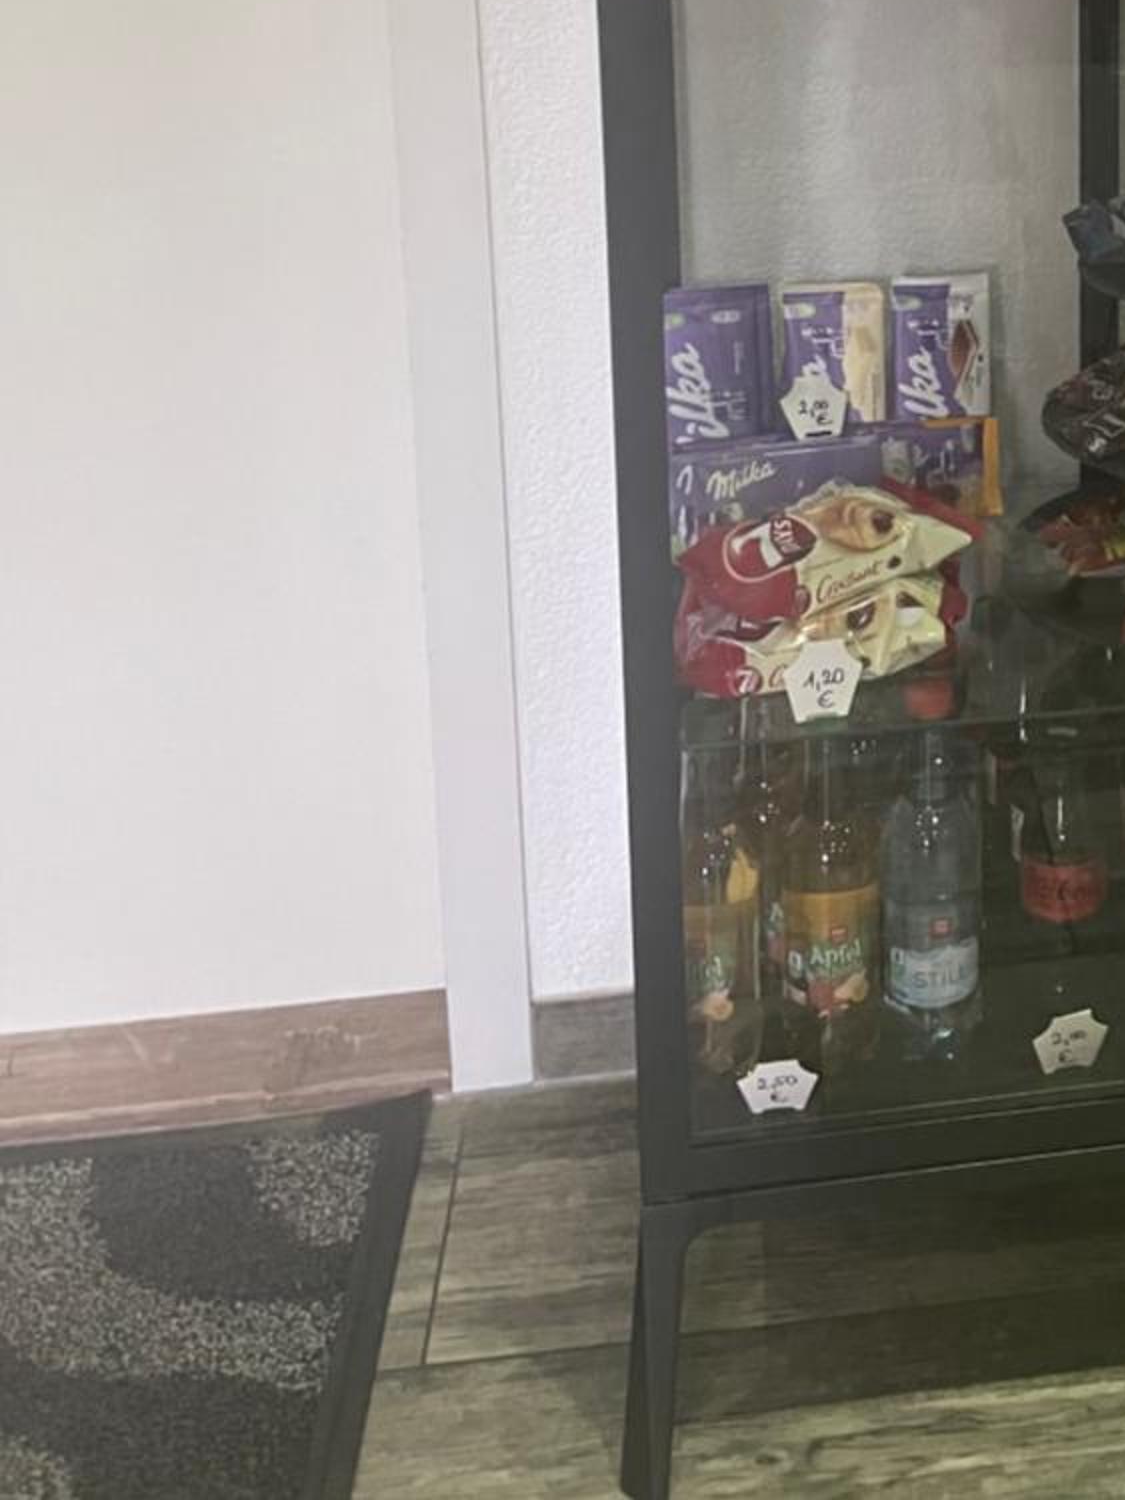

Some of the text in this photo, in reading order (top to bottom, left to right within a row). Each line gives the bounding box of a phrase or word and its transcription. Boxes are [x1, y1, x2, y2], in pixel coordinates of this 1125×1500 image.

[704, 458, 776, 499] Milka
[802, 667, 846, 692] 1,20
[816, 691, 836, 709] €
